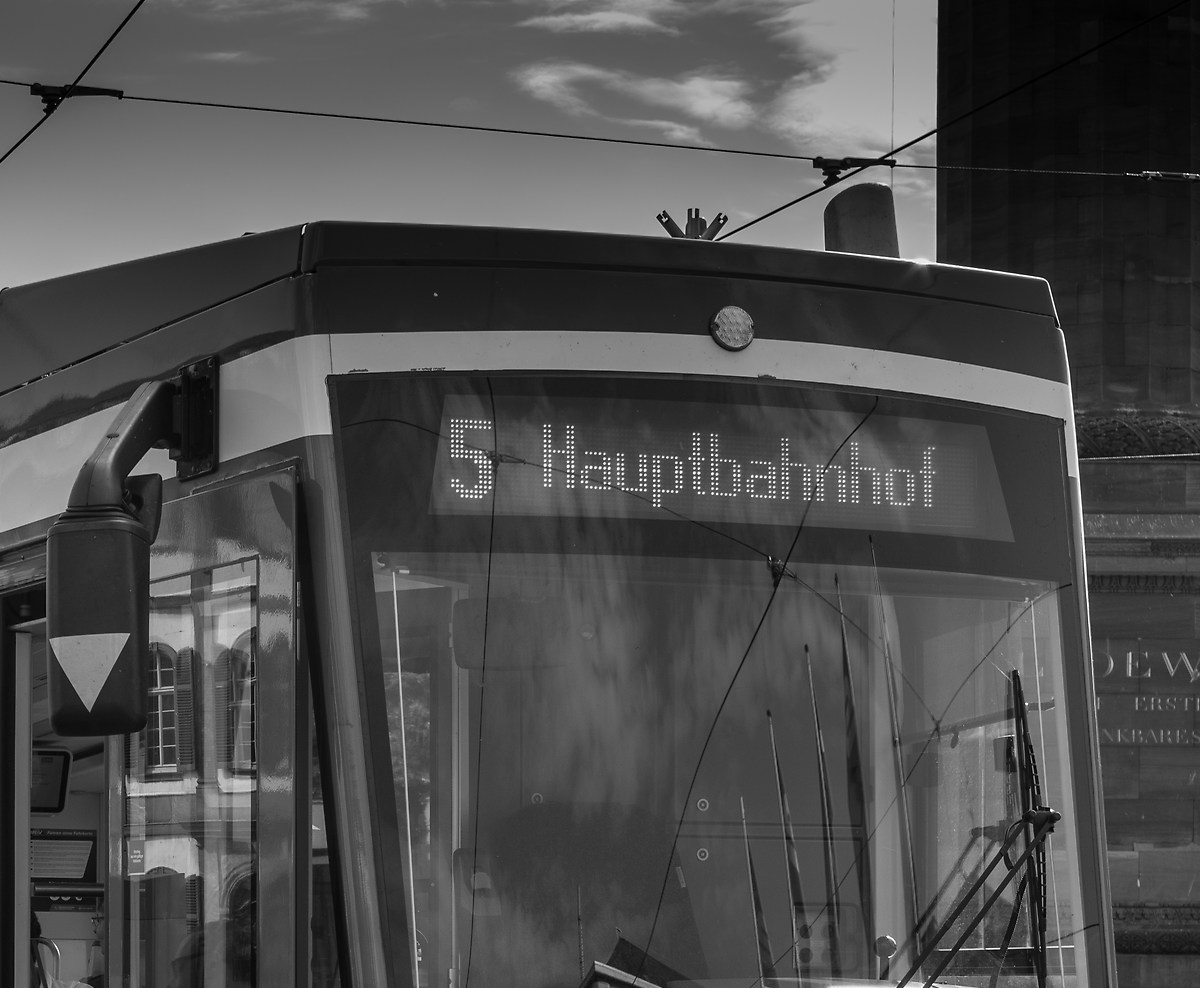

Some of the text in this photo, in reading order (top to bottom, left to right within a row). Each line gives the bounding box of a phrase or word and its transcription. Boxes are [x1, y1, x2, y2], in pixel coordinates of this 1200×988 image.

[449, 418, 937, 509] 5 Hauptbahnhof
[1134, 696, 1200, 712] ERST
